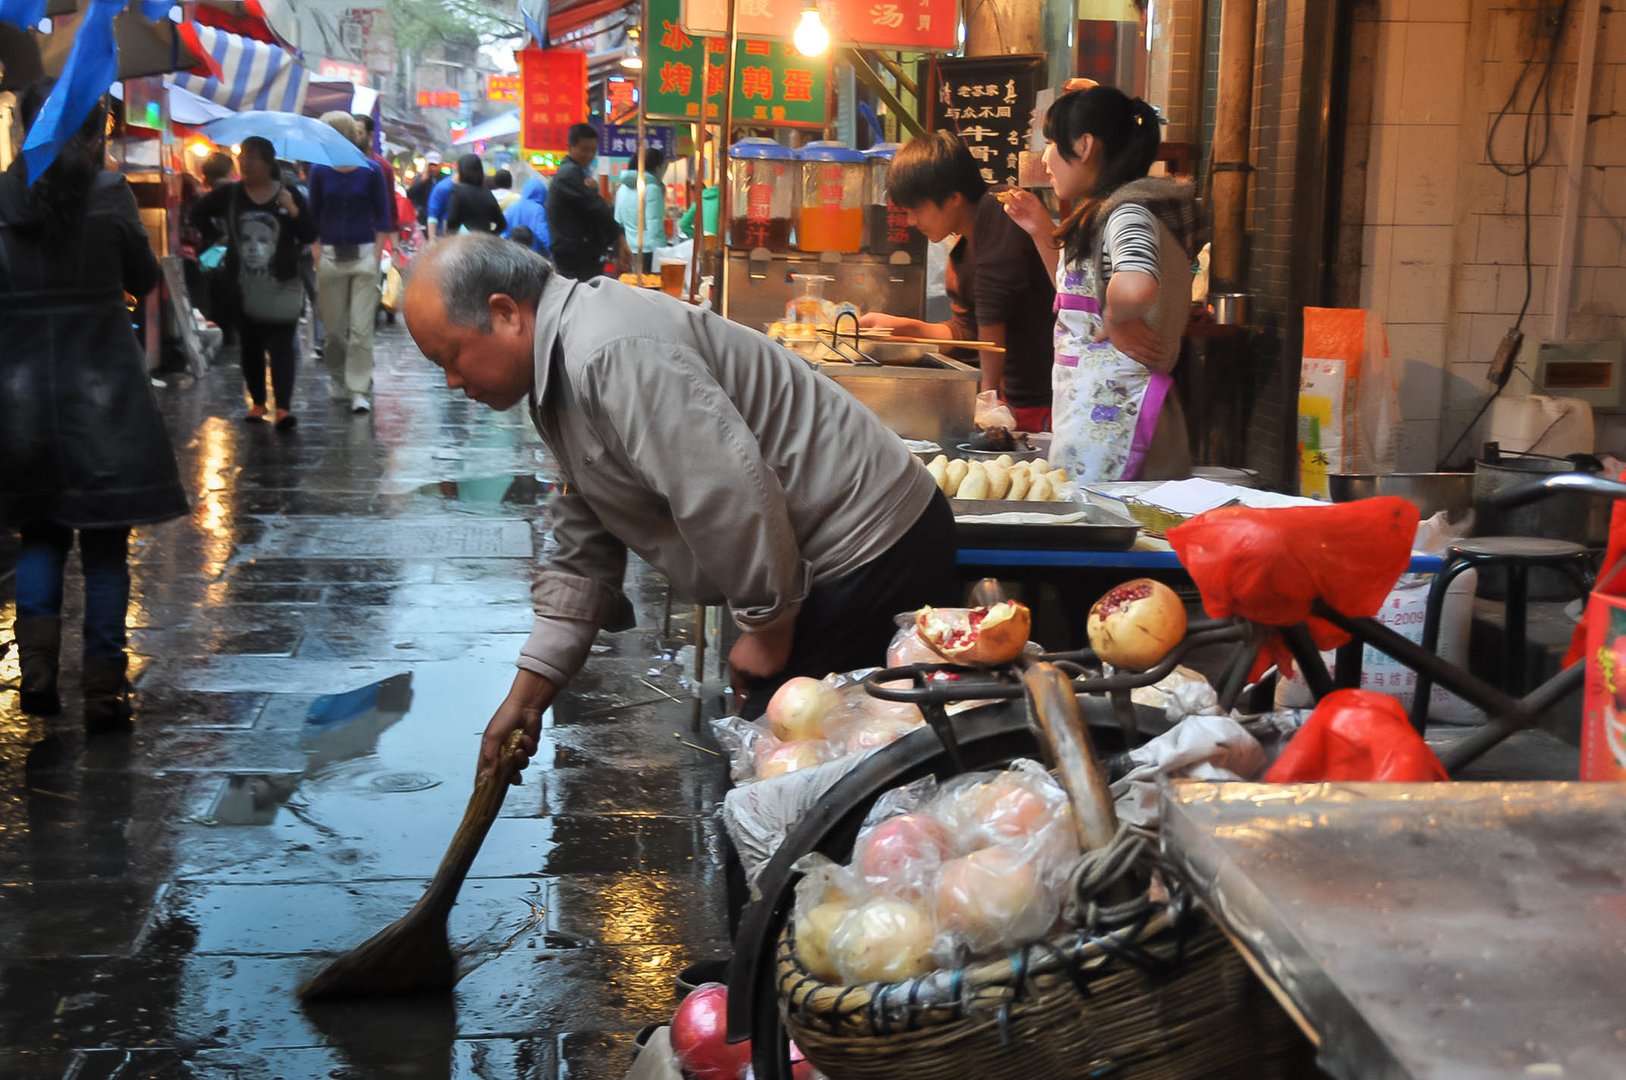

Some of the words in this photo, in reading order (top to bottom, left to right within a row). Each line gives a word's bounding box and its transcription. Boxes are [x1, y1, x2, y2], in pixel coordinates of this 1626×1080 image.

[660, 61, 814, 103] 烤鹌鹑蛋
[944, 106, 1011, 119] 与众不同
[1376, 611, 1424, 626] 4-2009
